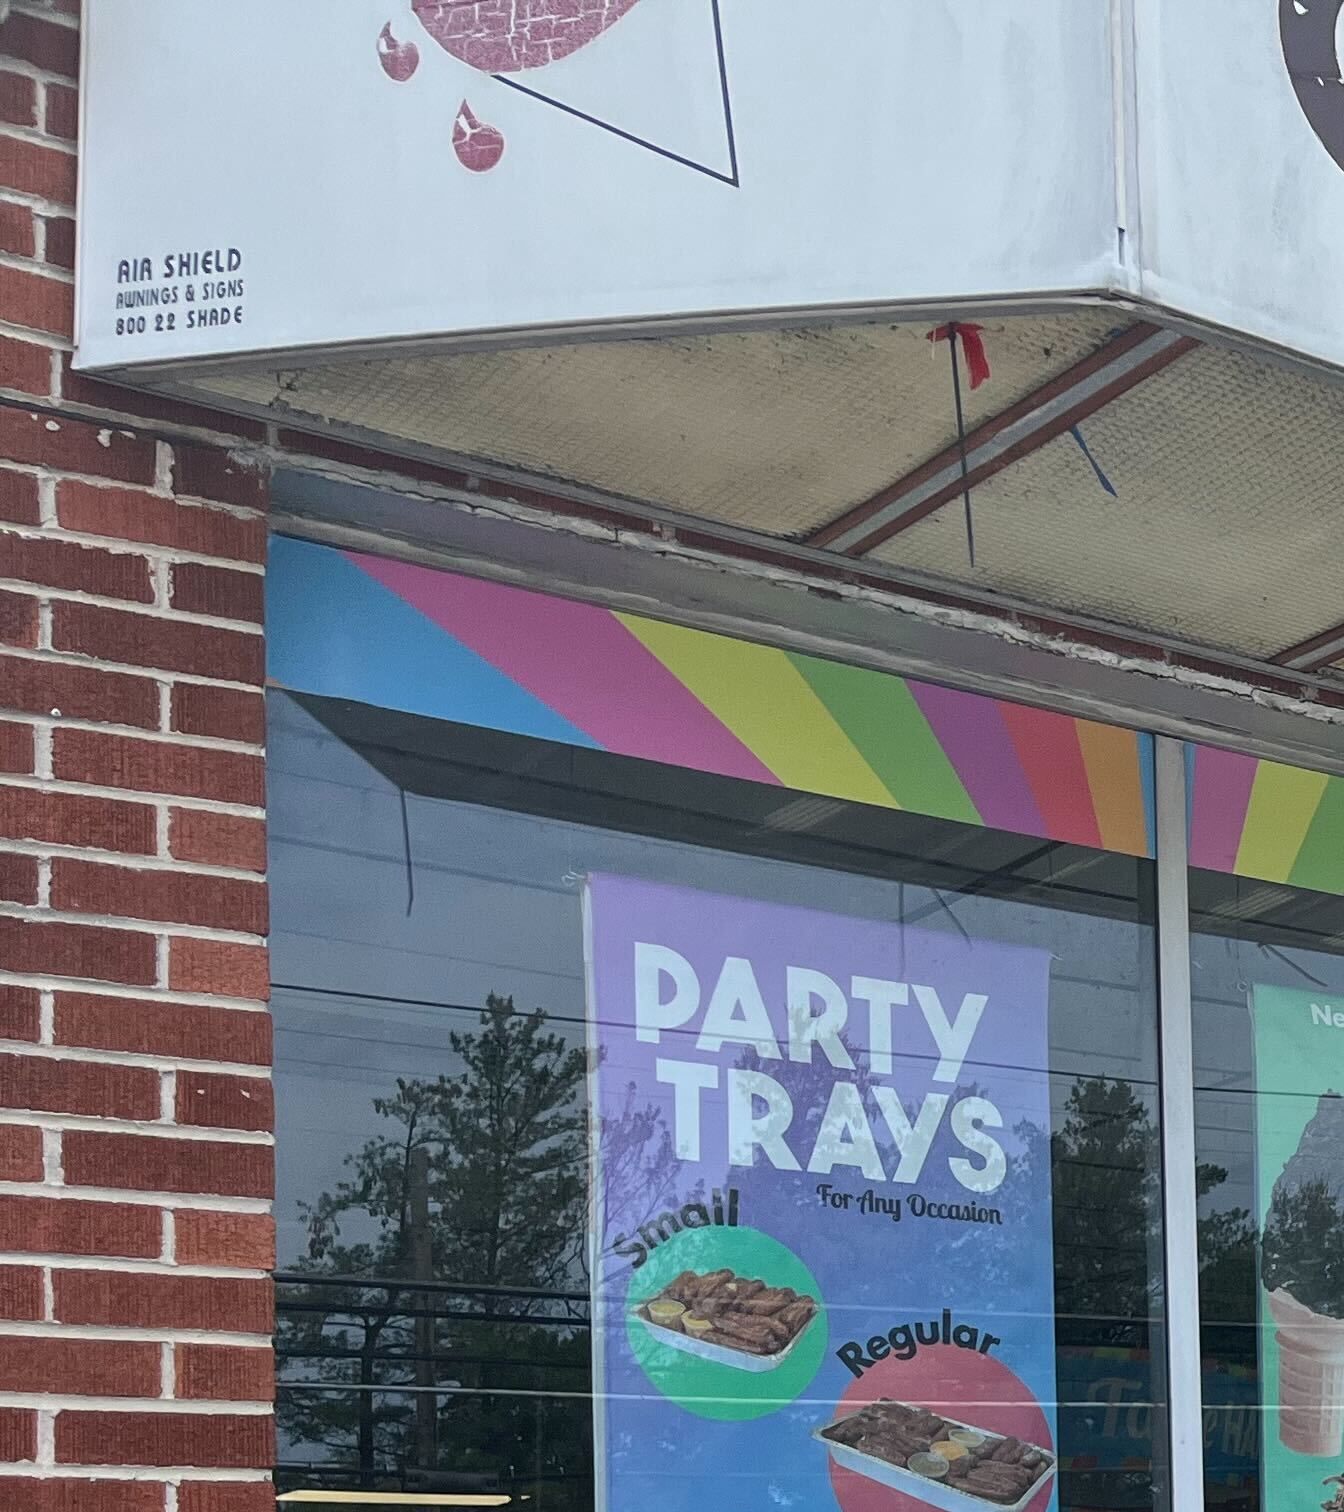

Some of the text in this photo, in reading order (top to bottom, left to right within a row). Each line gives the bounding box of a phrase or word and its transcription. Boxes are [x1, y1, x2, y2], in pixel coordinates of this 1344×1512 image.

[117, 248, 242, 283] AIR SHIELD
[115, 305, 244, 336] 800 22 SHADE
[116, 278, 245, 310] AWNINGS & SIGNS
[633, 941, 989, 1083] PARTY
[655, 1057, 1007, 1193] TRAYS
[613, 1187, 739, 1269] Small
[816, 1184, 1003, 1225] For Any Occasion
[835, 1308, 1001, 1378] Regular
